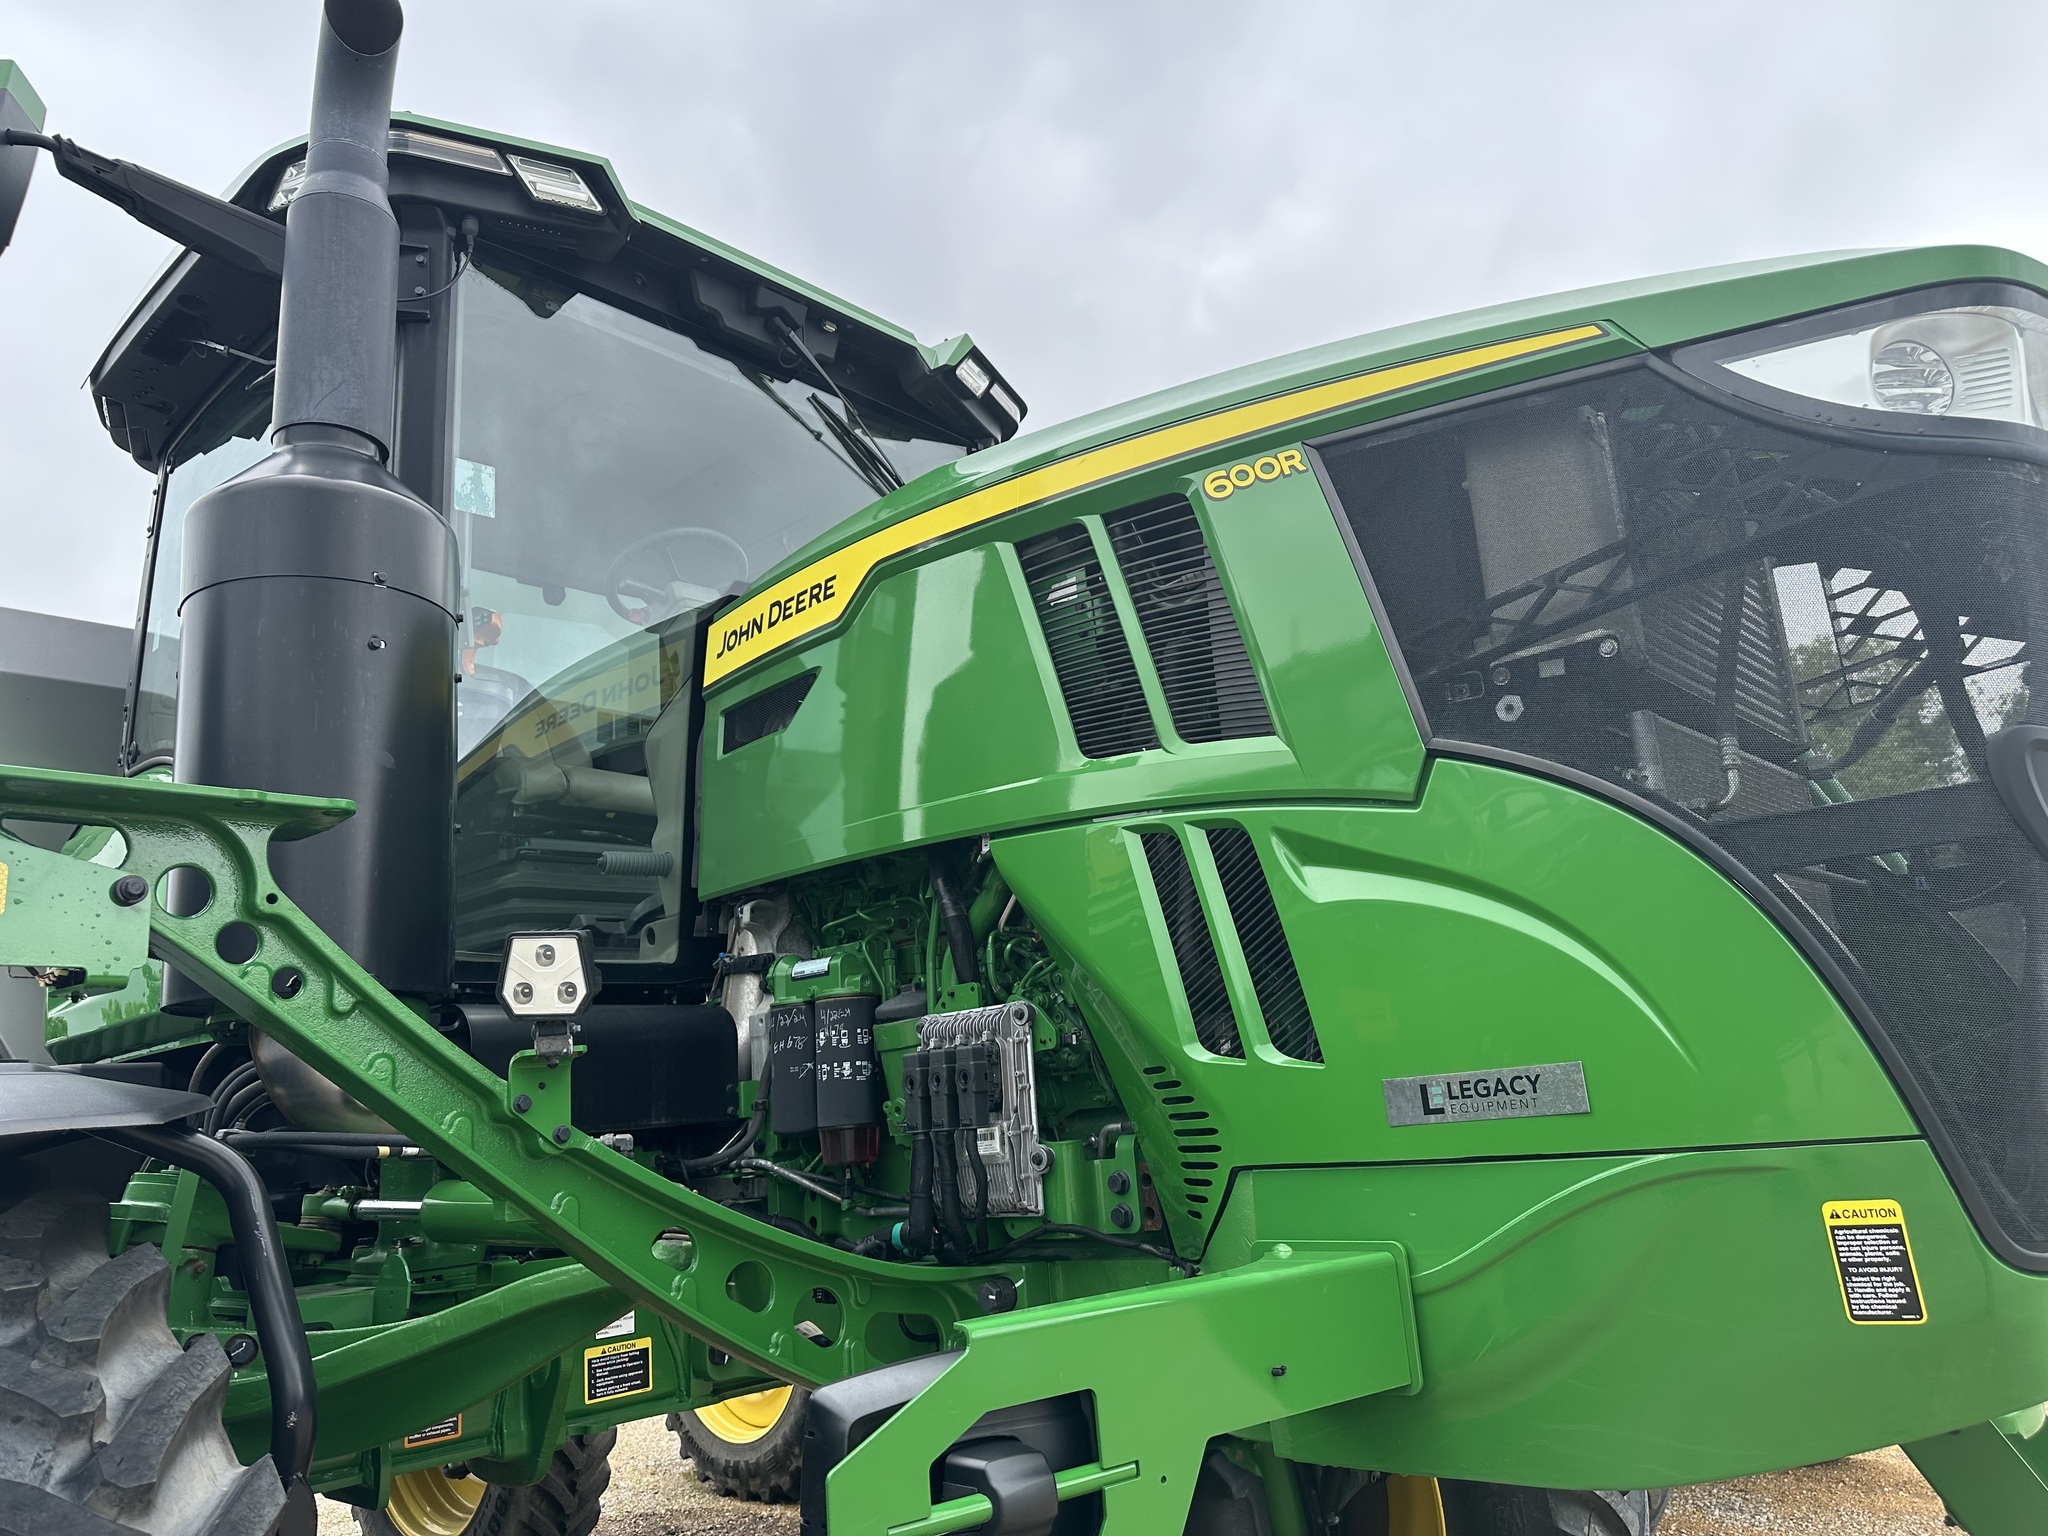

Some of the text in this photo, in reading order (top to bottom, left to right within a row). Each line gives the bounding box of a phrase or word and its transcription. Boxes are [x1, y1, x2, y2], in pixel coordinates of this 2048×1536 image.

[1203, 449, 1308, 501] 600R
[716, 574, 837, 659] JOHN DEERE
[1446, 1074, 1540, 1100] LEGACY
[1450, 1098, 1538, 1114] EQUIPMENT
[1842, 1208, 1896, 1218] CAUTION
[608, 1342, 636, 1353] CAUTION
